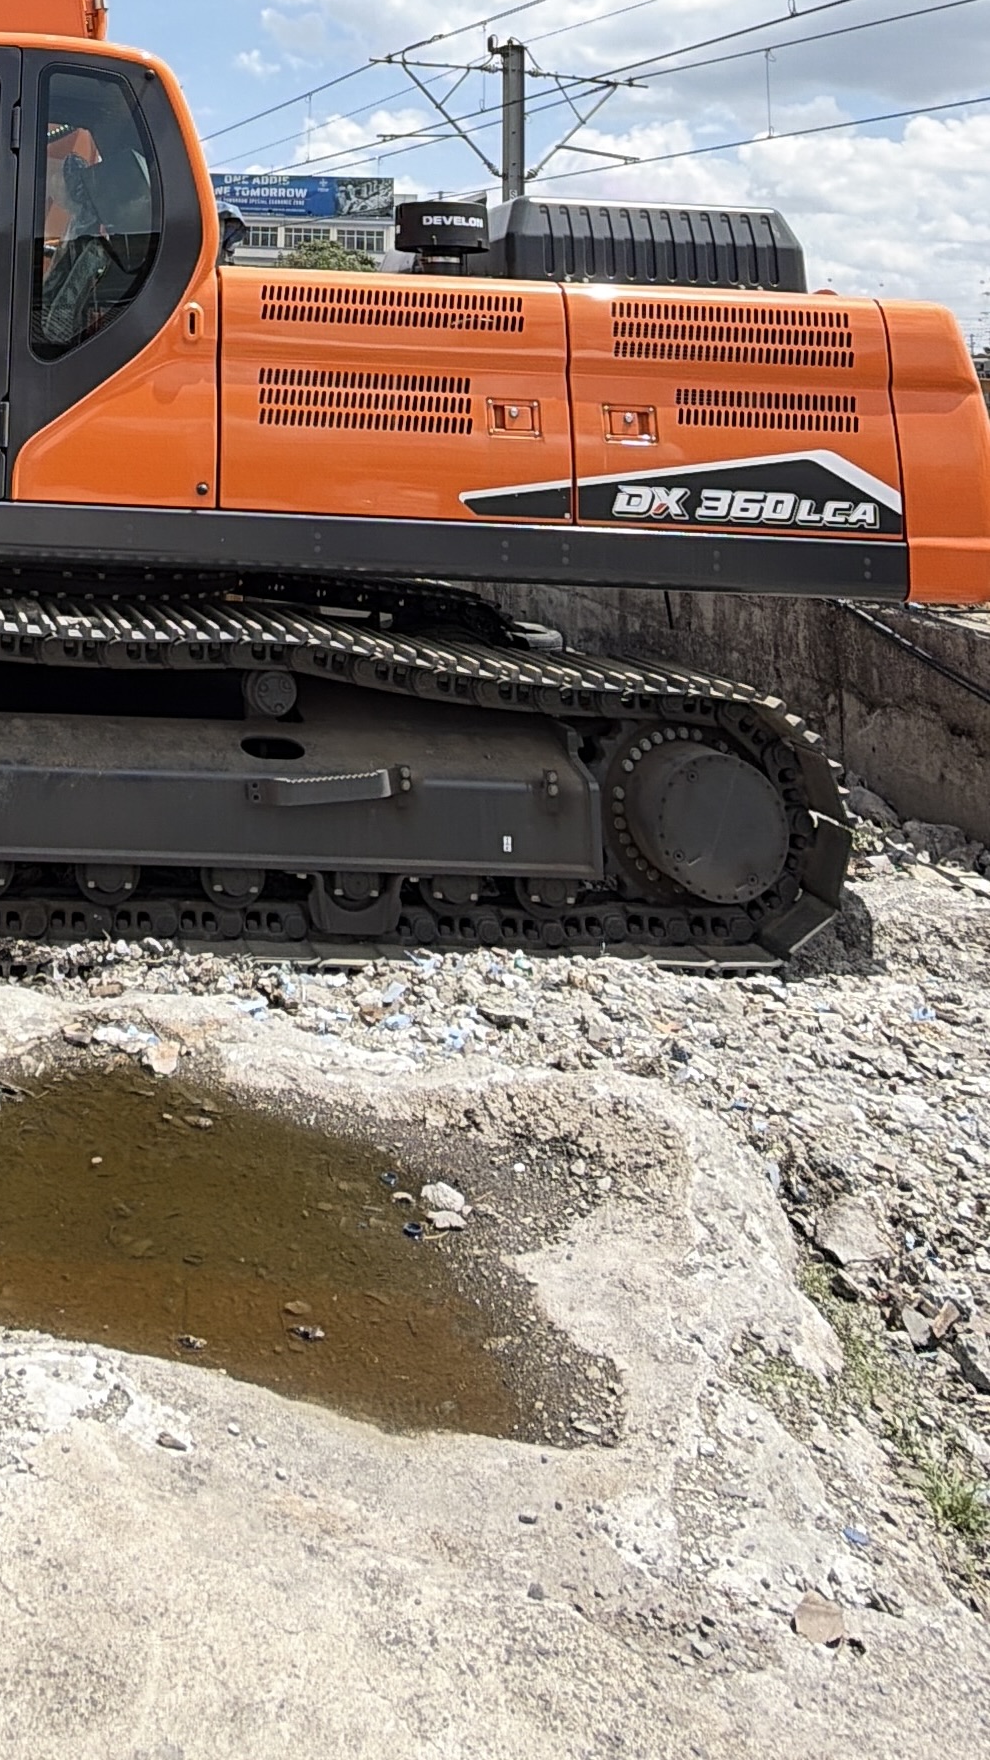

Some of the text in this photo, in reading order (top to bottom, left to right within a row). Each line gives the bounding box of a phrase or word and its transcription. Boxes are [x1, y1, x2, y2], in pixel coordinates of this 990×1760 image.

[224, 175, 290, 185] ONE ADDIS
[215, 186, 231, 196] NE
[234, 187, 308, 198] TOMORROW
[422, 215, 484, 228] DEVELON
[612, 485, 690, 520] DX
